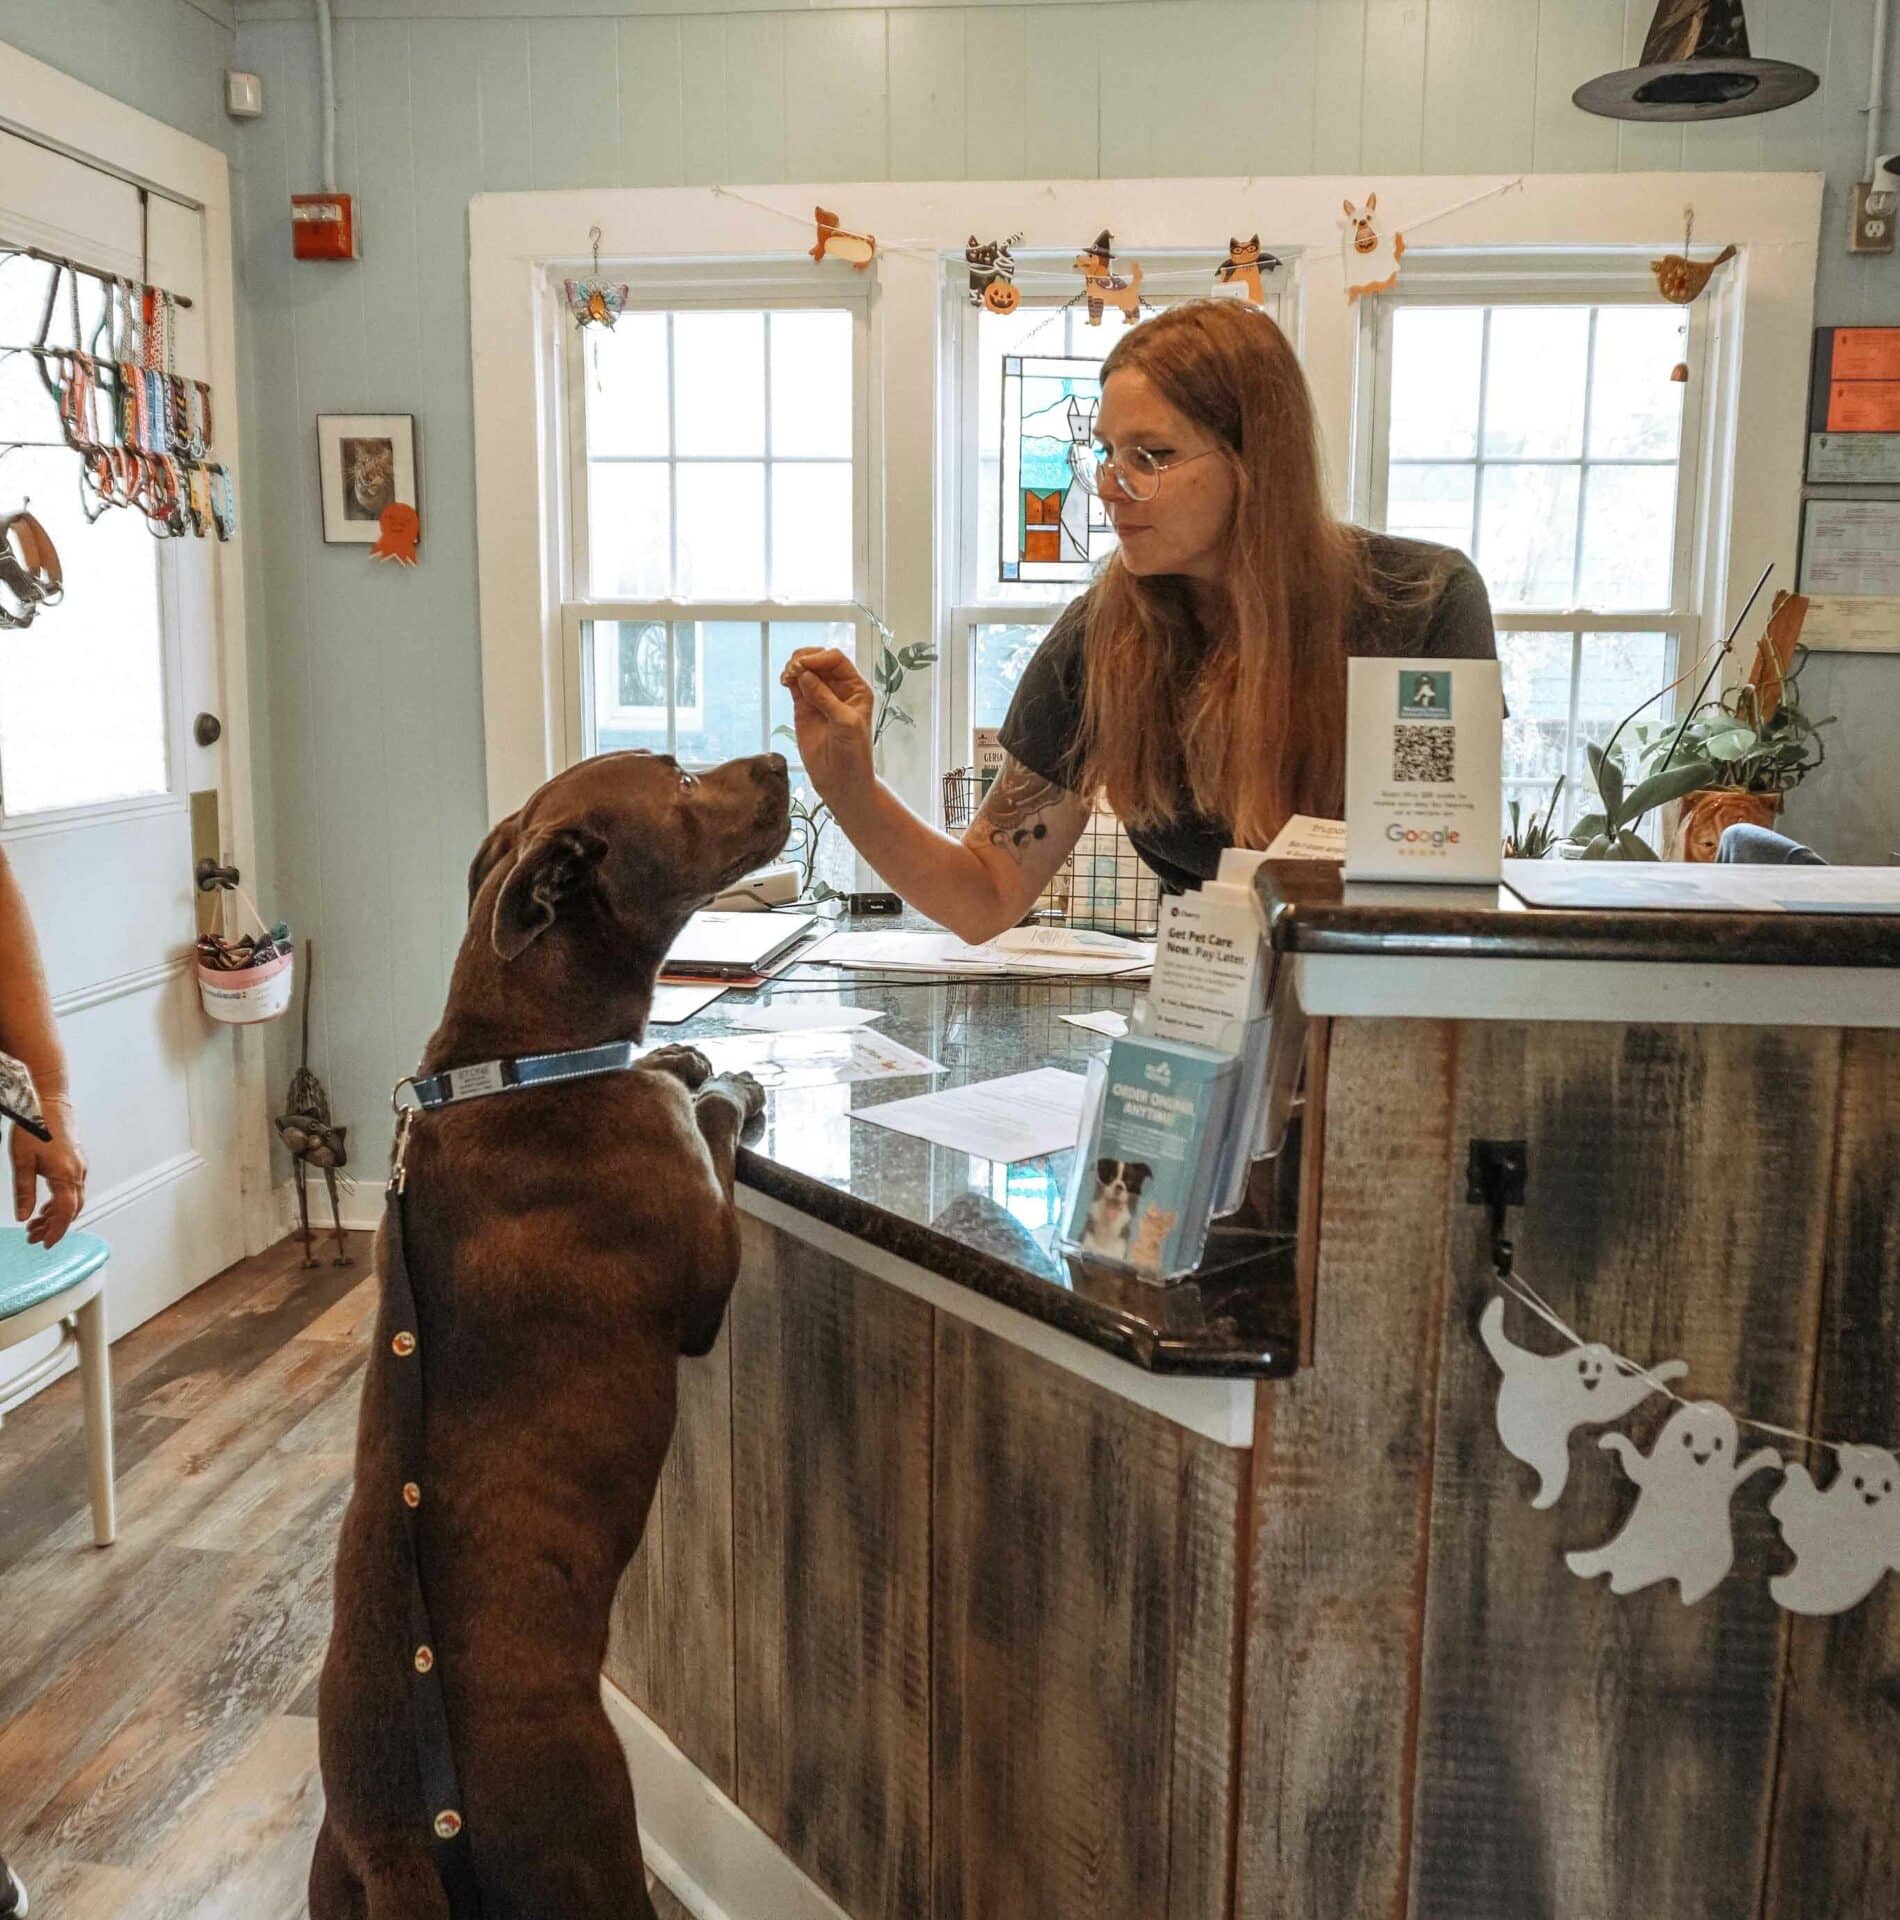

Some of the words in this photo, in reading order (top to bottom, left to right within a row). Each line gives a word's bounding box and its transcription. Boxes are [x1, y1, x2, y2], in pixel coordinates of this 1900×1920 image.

[983, 752, 1004, 762] GERIA
[1385, 823, 1460, 848] Google
[1168, 927, 1186, 940] Get
[1189, 930, 1206, 944] Pet
[1208, 934, 1234, 948] Care
[1167, 942, 1193, 956] Now.
[1195, 946, 1213, 962] Pay
